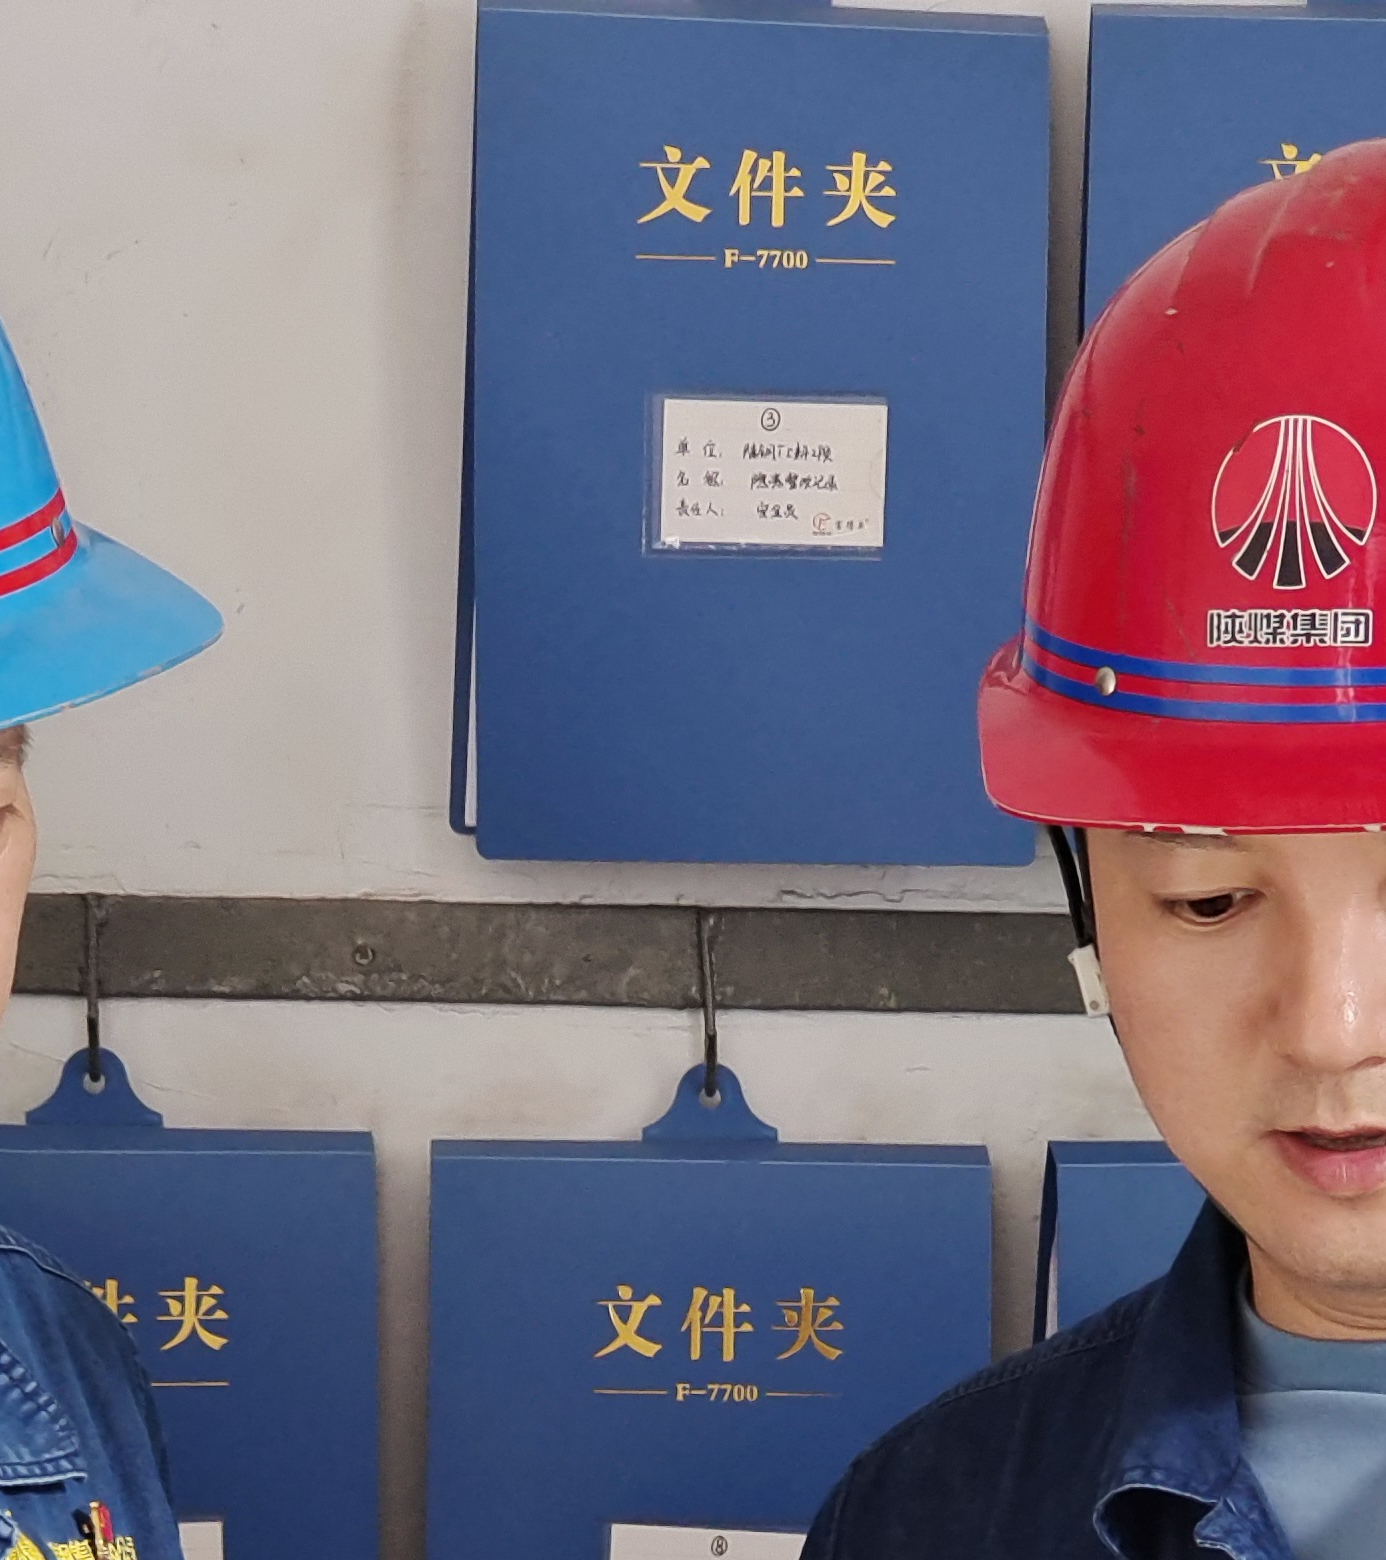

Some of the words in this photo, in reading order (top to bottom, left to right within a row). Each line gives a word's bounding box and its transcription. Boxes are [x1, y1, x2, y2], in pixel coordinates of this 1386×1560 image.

[637, 145, 897, 229] 文件夹
[723, 248, 809, 270] F-7700
[1207, 609, 1372, 647] 陕煤集团
[593, 1284, 844, 1363] 文件夹
[675, 1382, 760, 1403] F-7700
